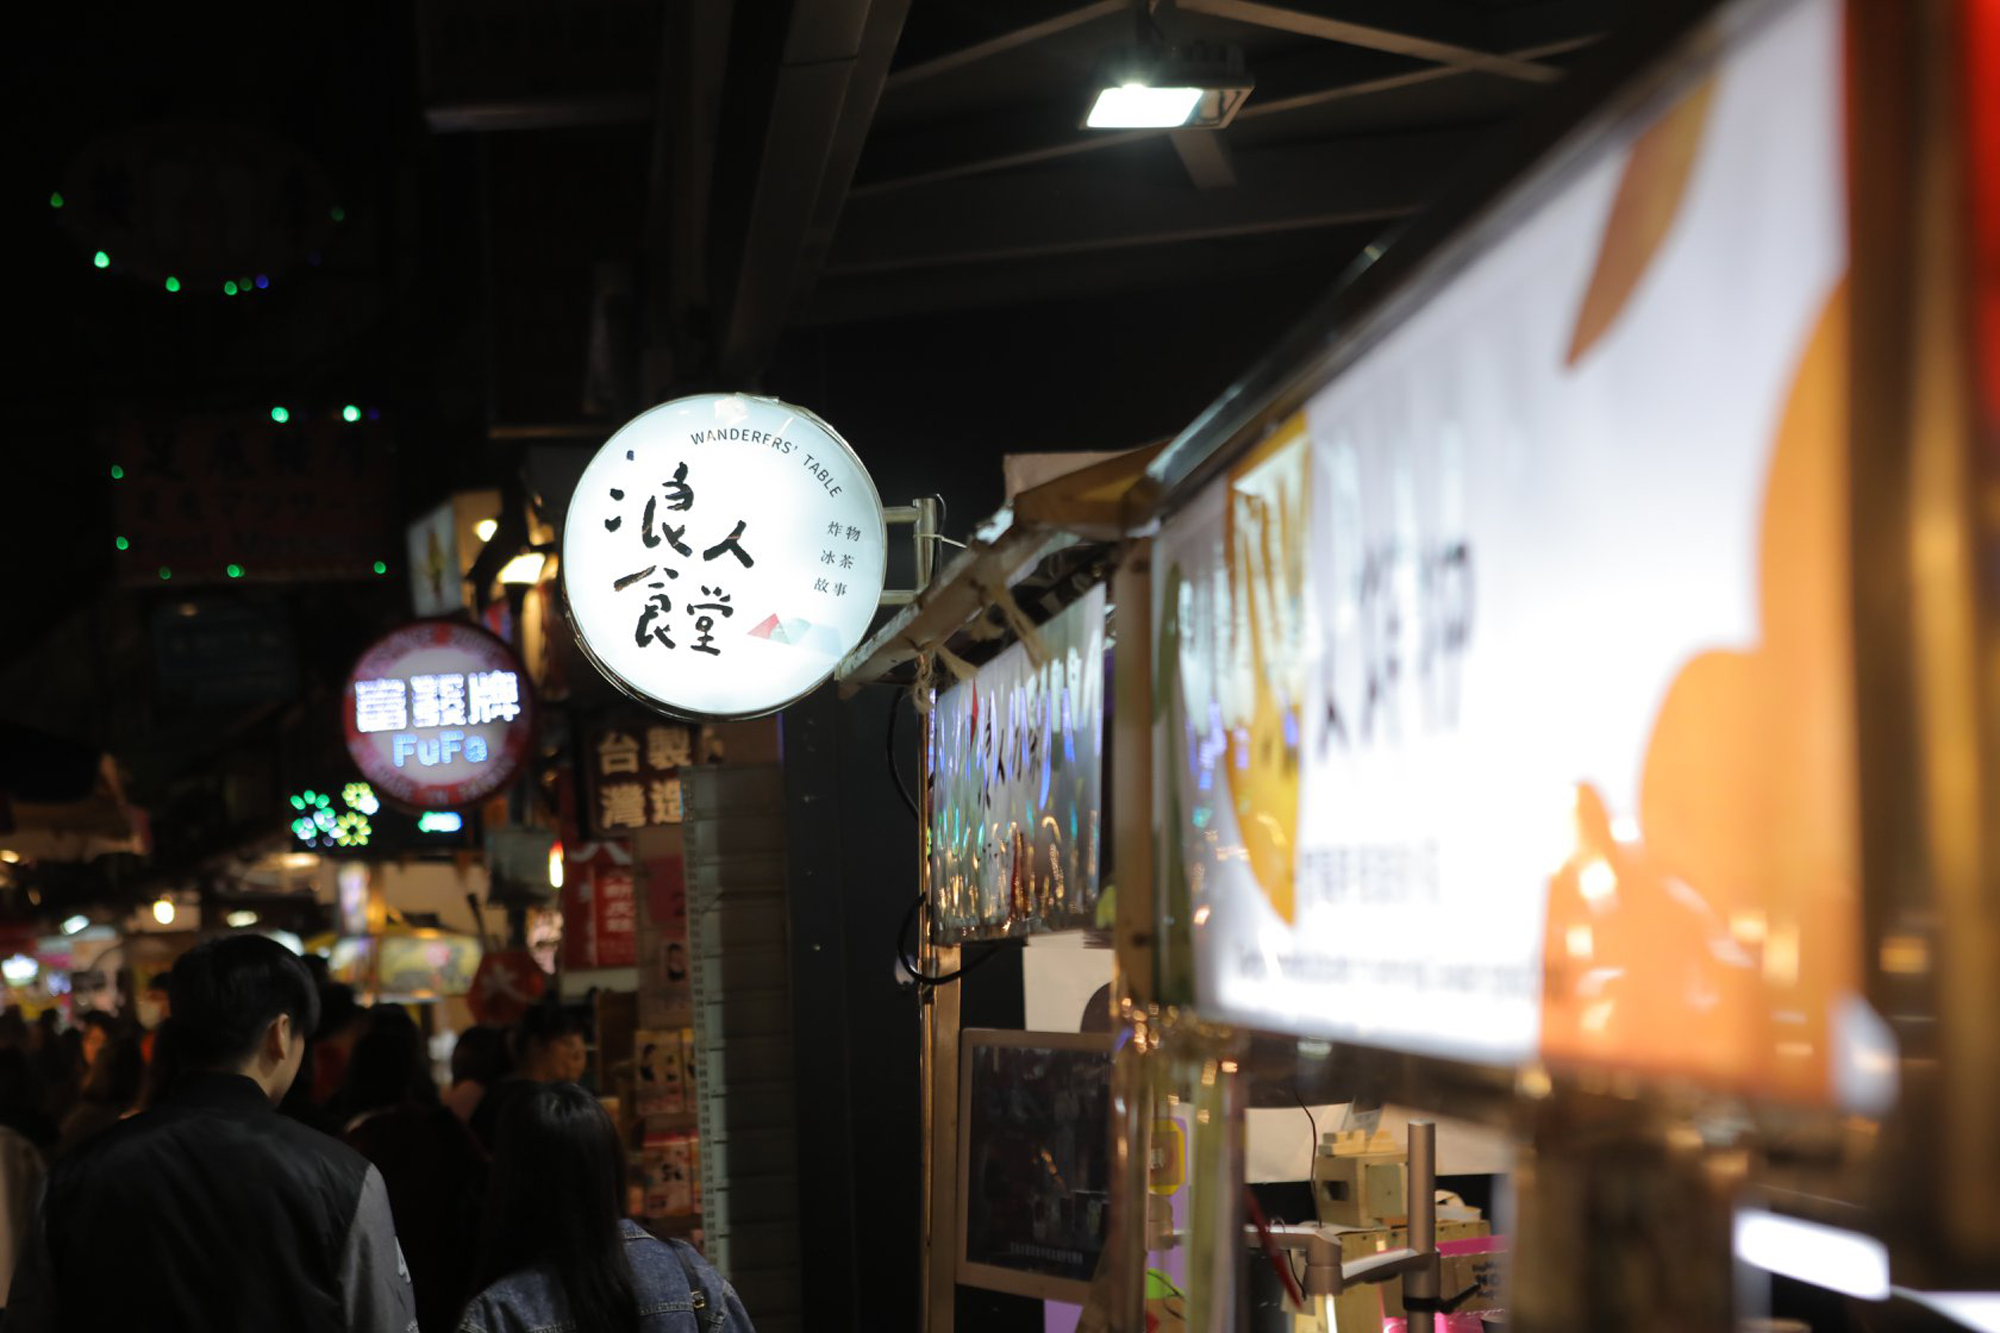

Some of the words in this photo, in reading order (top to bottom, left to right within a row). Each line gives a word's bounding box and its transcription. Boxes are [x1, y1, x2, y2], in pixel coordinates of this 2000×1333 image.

[803, 454, 843, 498] TABLE
[604, 449, 754, 568] 浪人
[827, 521, 861, 542] 炸物
[820, 550, 854, 570] 冰茶
[814, 577, 848, 597] 故事
[613, 565, 734, 656] 食堂
